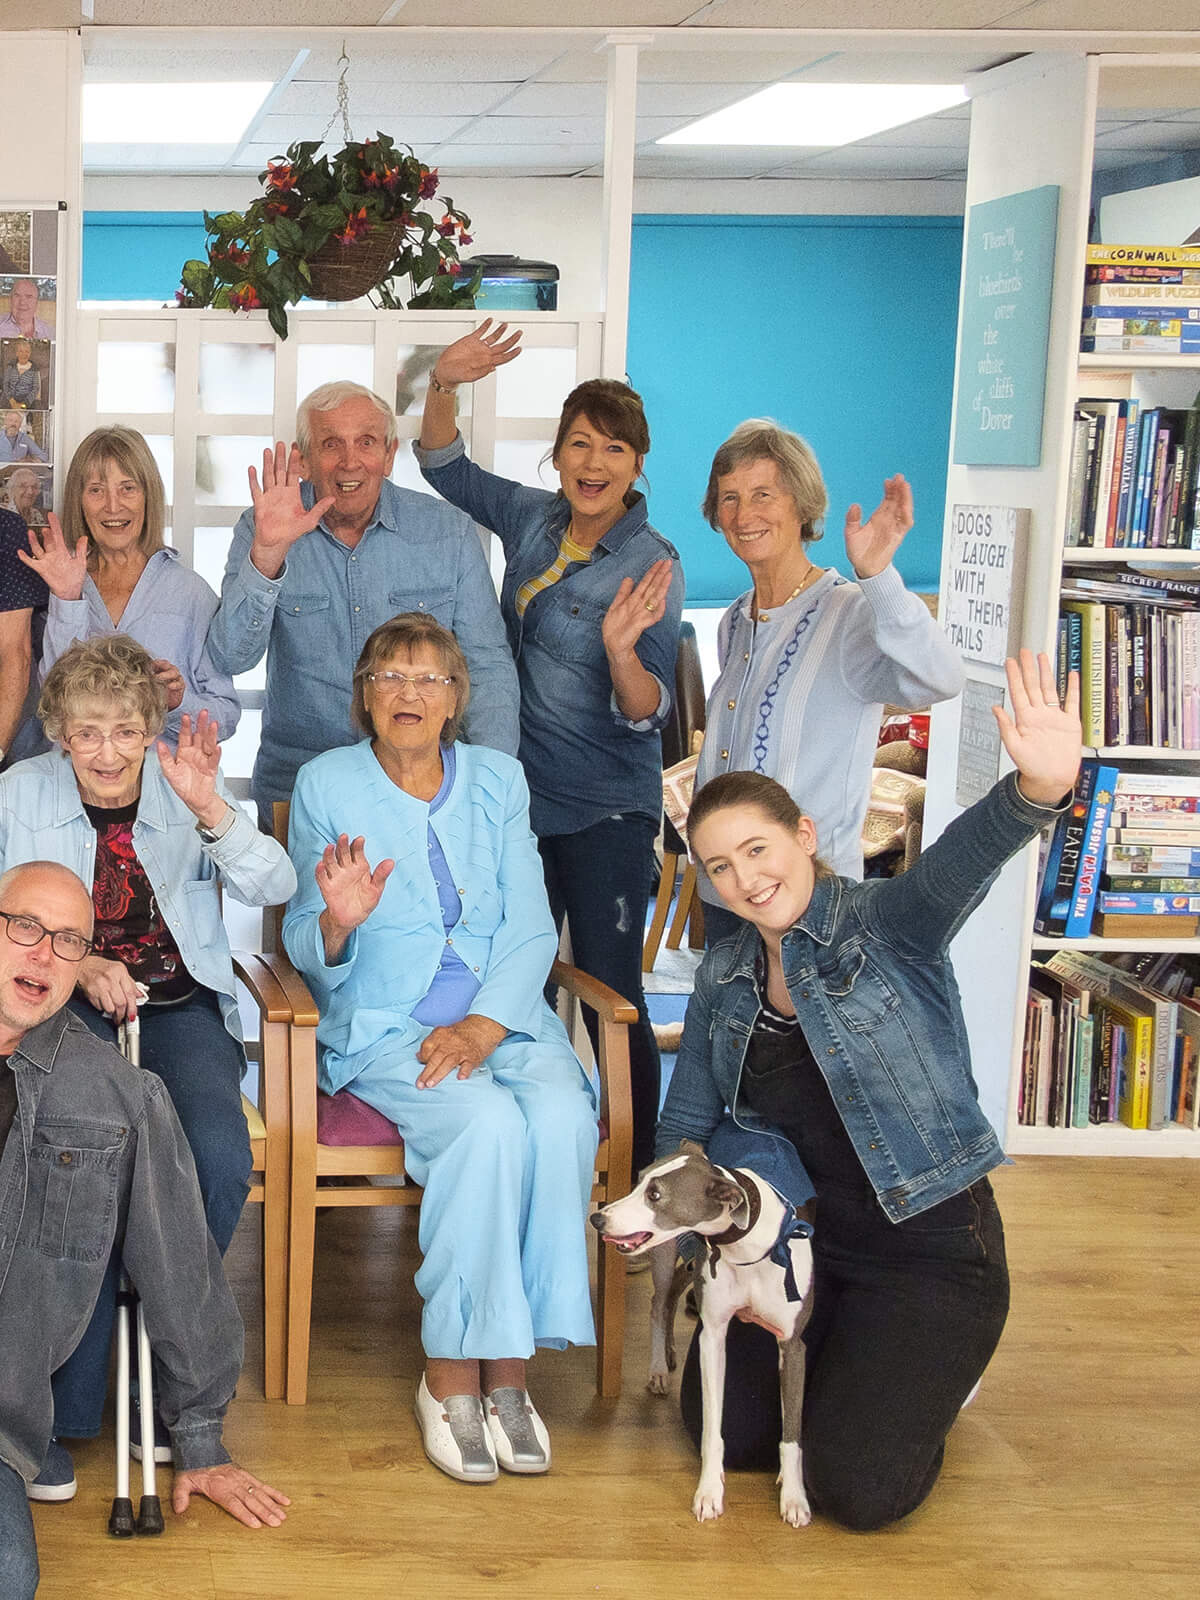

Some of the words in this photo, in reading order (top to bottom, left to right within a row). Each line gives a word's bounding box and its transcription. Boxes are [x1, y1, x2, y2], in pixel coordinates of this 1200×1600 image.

[1110, 249, 1177, 262] CORNWALL
[980, 406, 1013, 430] Dover
[1125, 427, 1136, 464] WORLD
[1120, 464, 1132, 494] ATLAS
[957, 512, 992, 537] DOGS
[962, 541, 1007, 568] LAUGH
[954, 568, 986, 595] WITH
[1120, 575, 1158, 588] SECRET
[1161, 581, 1200, 594] FRANCE
[968, 599, 1004, 627] THEIR
[951, 623, 984, 652] TAILS
[1091, 640, 1102, 686] BRITISH
[1091, 690, 1102, 724] BIRDS
[962, 727, 996, 752] HAPPY
[1092, 807, 1107, 854] JIGSAW
[1058, 826, 1083, 887] EARTH
[1079, 856, 1096, 895] BATH
[1074, 896, 1088, 918] THE
